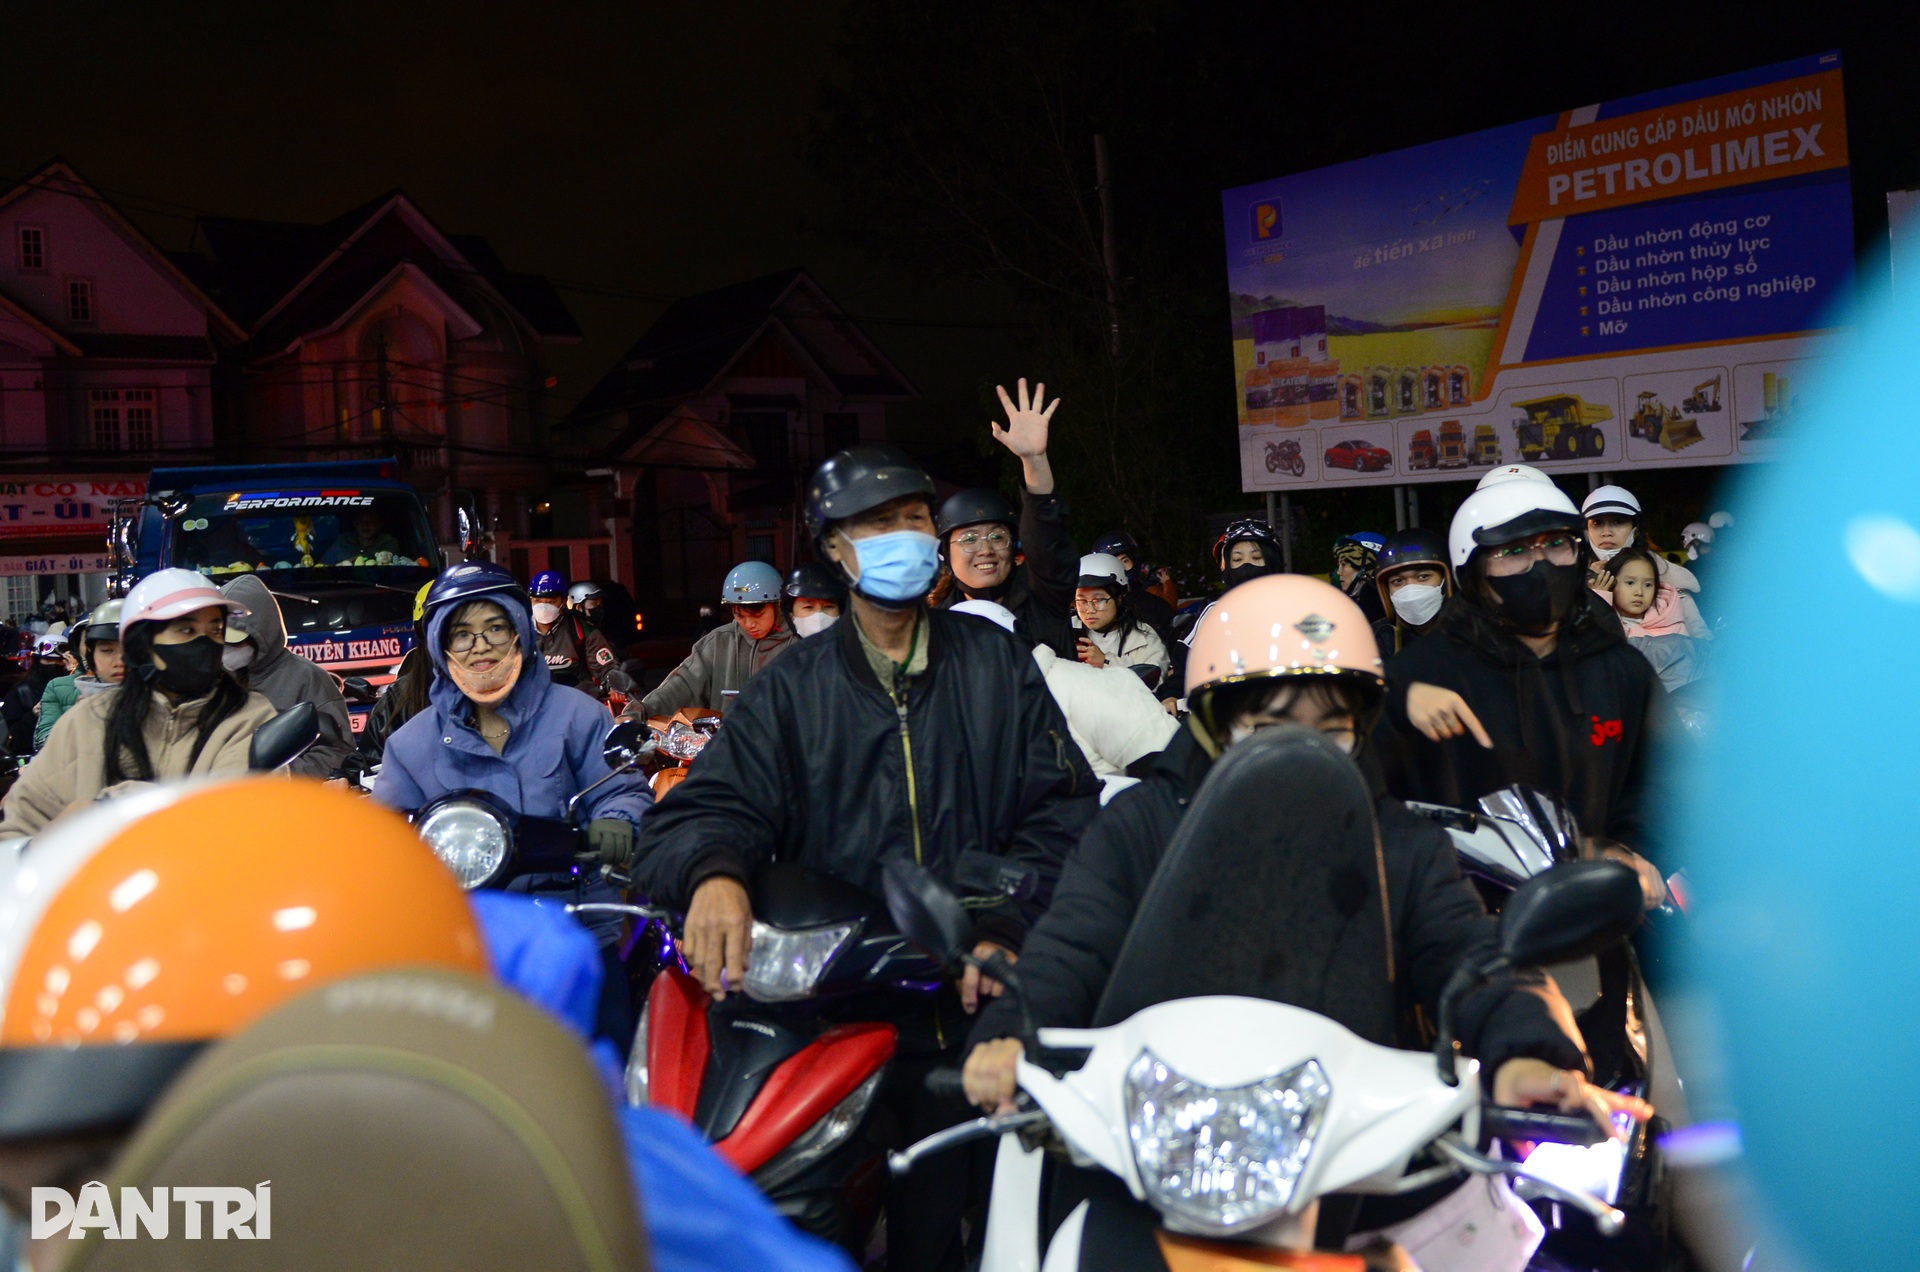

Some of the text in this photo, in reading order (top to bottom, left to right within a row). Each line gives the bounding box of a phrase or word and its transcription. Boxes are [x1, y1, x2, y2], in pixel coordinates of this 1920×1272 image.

[1546, 133, 1587, 165] ĐIỂM
[1590, 126, 1640, 156] CUNG
[1644, 113, 1677, 144] CẤP
[1682, 104, 1720, 136] DẦU
[1761, 87, 1823, 122] NHỜN
[1548, 122, 1825, 206] PETROLIMEX
[1375, 239, 1414, 264] tiến
[1418, 235, 1444, 254] xa
[1594, 214, 1771, 254] Dầu nhờn động cơ
[1595, 236, 1771, 275] Dầu nhờn thủy lực
[1596, 255, 1758, 295] Dầu nhờn hộp số
[1597, 274, 1817, 316] Dầu nhờn công nghiệp
[1599, 319, 1628, 336] Mỡ
[54, 498, 91, 519] ỦI
[223, 496, 375, 511] PERFORMANCE
[347, 637, 400, 659] KHANG
[352, 718, 360, 730] 5
